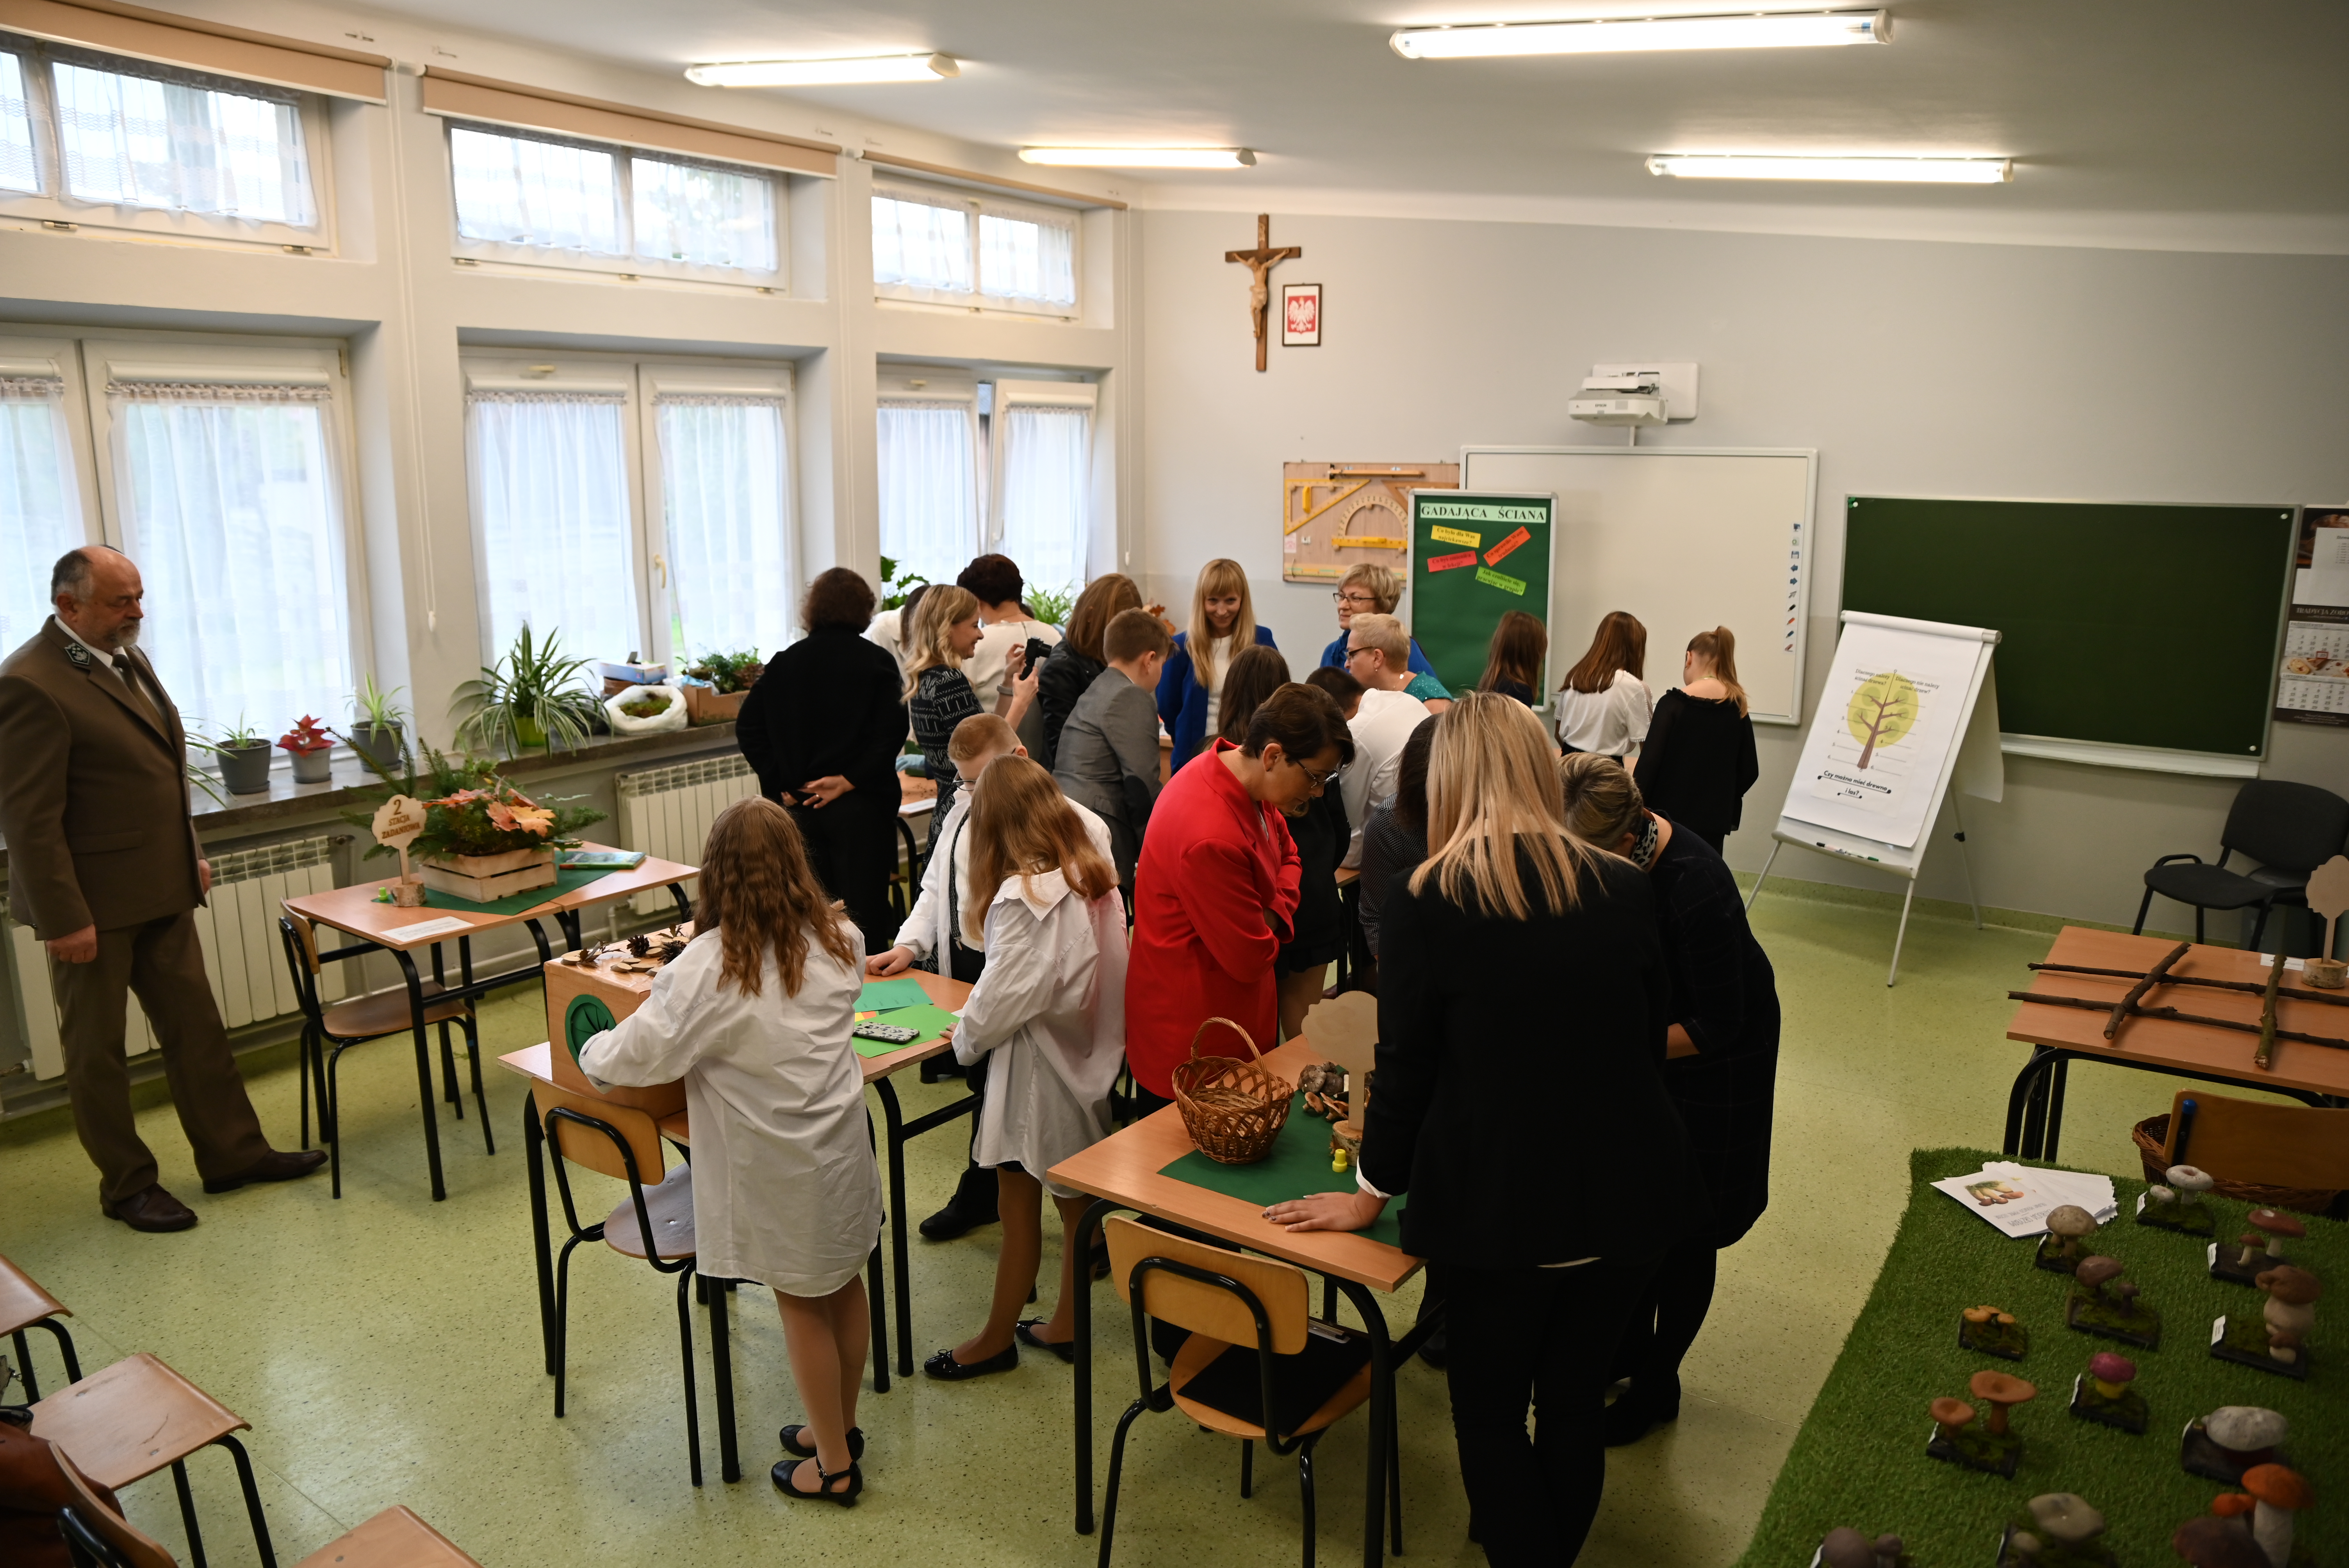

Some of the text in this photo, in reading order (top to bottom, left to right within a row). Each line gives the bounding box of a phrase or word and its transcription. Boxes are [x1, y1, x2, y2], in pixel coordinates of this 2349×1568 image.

[1421, 506, 1544, 520] GADAJĄCA ŚCIANA
[1511, 530, 1523, 539] Wam
[1438, 535, 1472, 545] najciekawsze?
[1492, 574, 1512, 583] czuliście
[1504, 585, 1523, 594] grupie?
[1855, 668, 1875, 677] Dlaczego
[1895, 676, 1916, 685] Dlaczego
[1824, 770, 1833, 779] Czy
[1866, 781, 1887, 791] drewno
[1848, 788, 1859, 796] las?
[393, 799, 401, 815] 2
[389, 814, 410, 826] STACJA
[382, 822, 421, 839] ZADANIOWA
